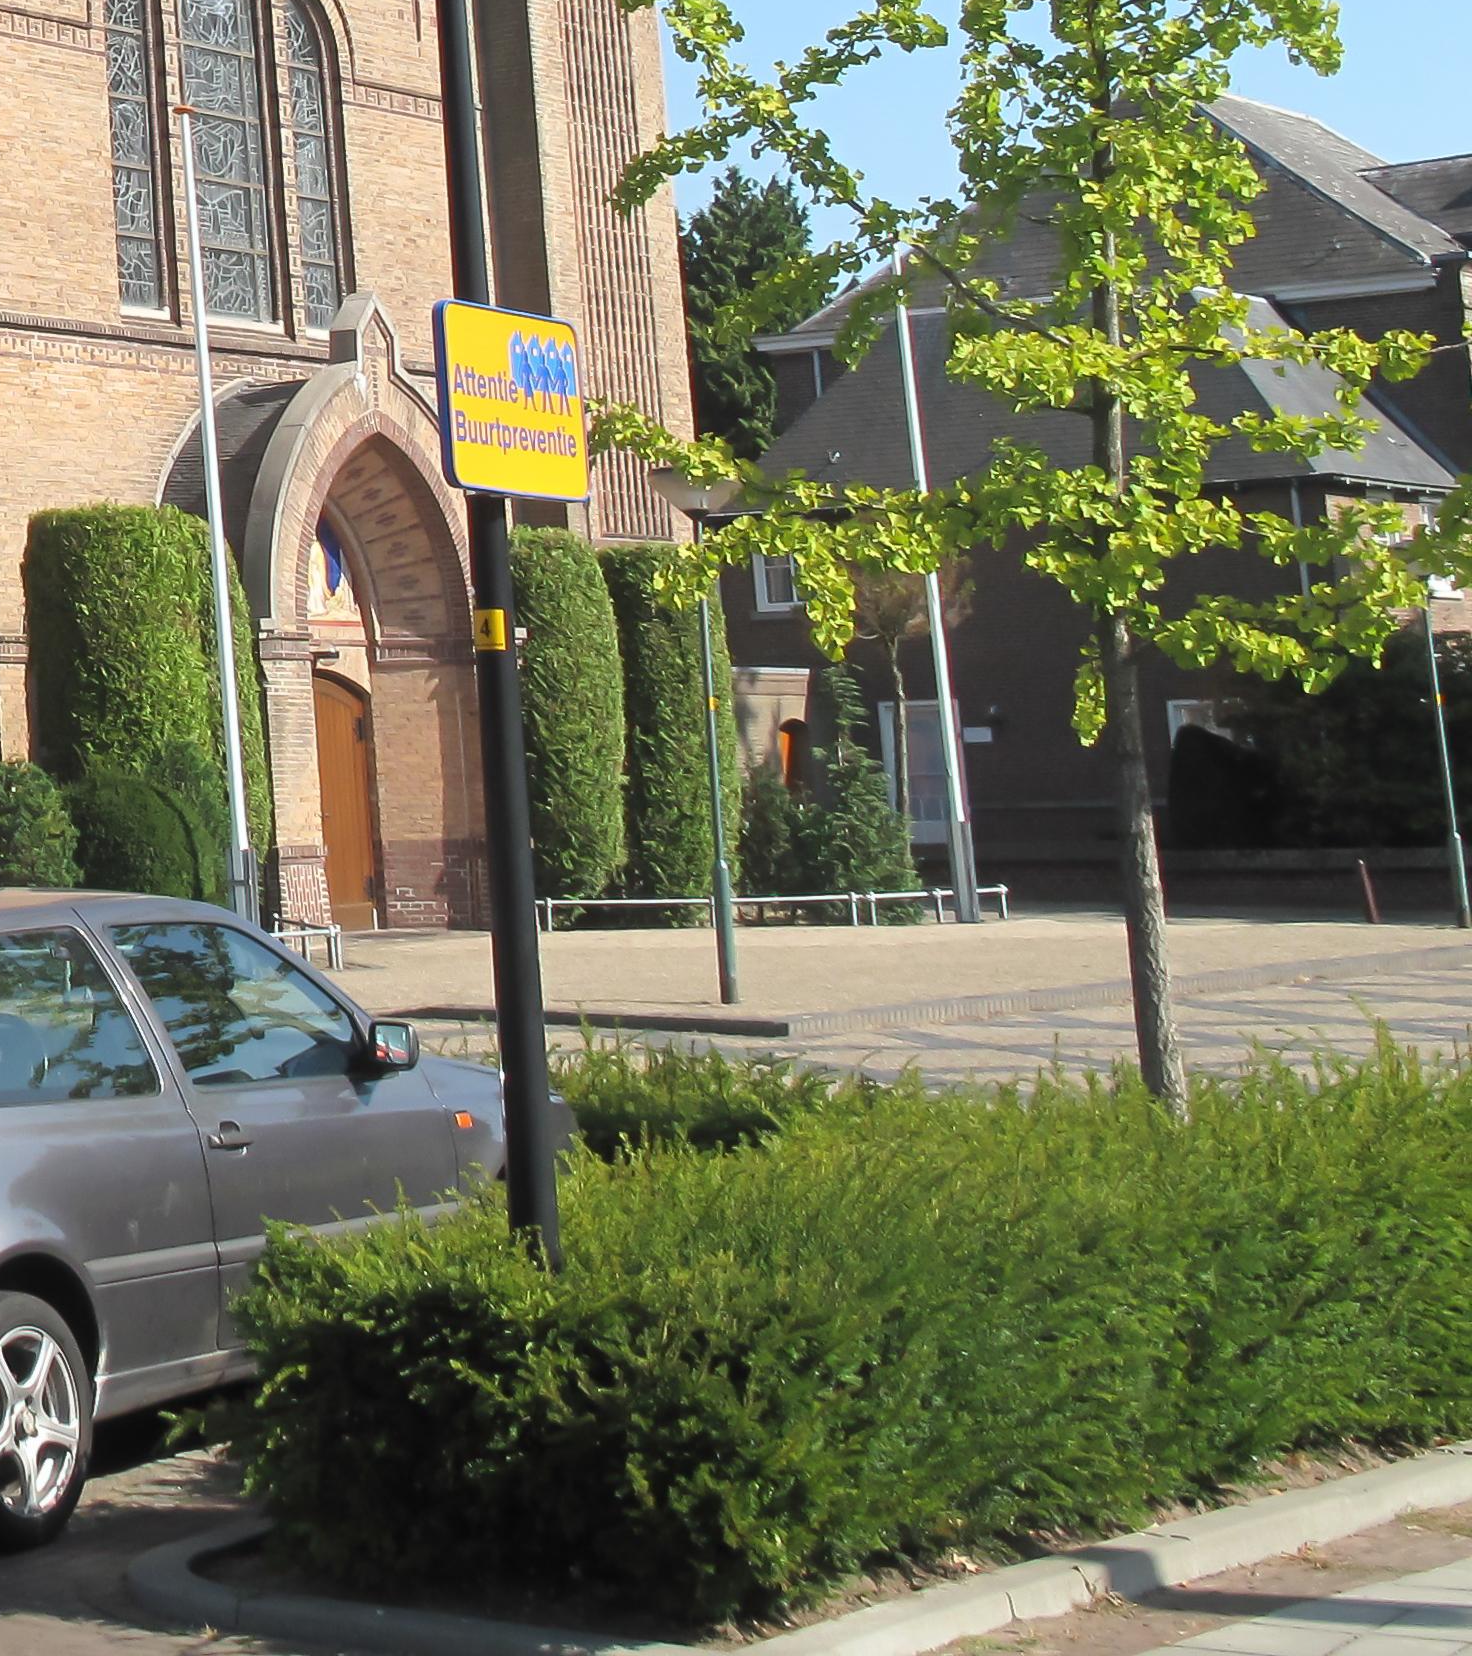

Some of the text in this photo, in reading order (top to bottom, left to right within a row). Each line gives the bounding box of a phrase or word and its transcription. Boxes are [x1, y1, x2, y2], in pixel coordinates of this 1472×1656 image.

[453, 362, 519, 404] Attentie
[455, 409, 577, 458] Buurtpreventie
[479, 617, 492, 638] 4
